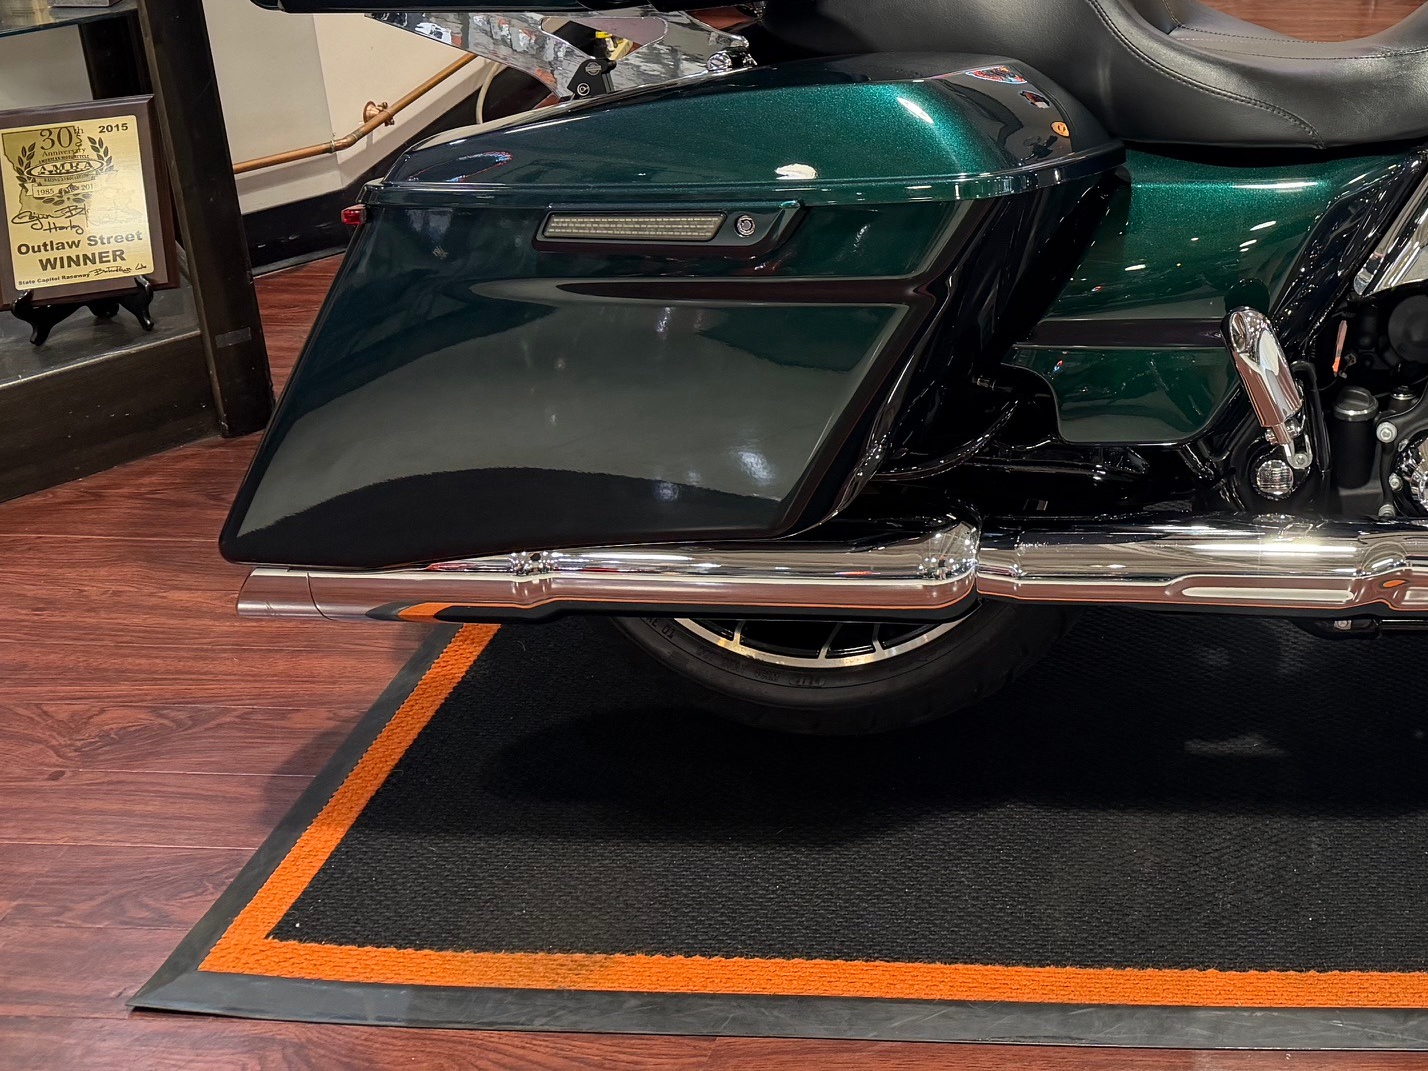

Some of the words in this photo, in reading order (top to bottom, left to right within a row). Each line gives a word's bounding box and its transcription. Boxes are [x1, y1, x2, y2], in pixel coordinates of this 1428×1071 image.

[98, 122, 129, 134] 2015
[42, 147, 86, 158] Anniversary
[39, 161, 94, 175] AMRA
[36, 188, 55, 196] 1985
[17, 238, 82, 256] Outlaw
[86, 230, 143, 248] Street
[38, 249, 127, 272] WINNER
[37, 276, 60, 285] Capitol
[61, 273, 91, 281] Raceway
